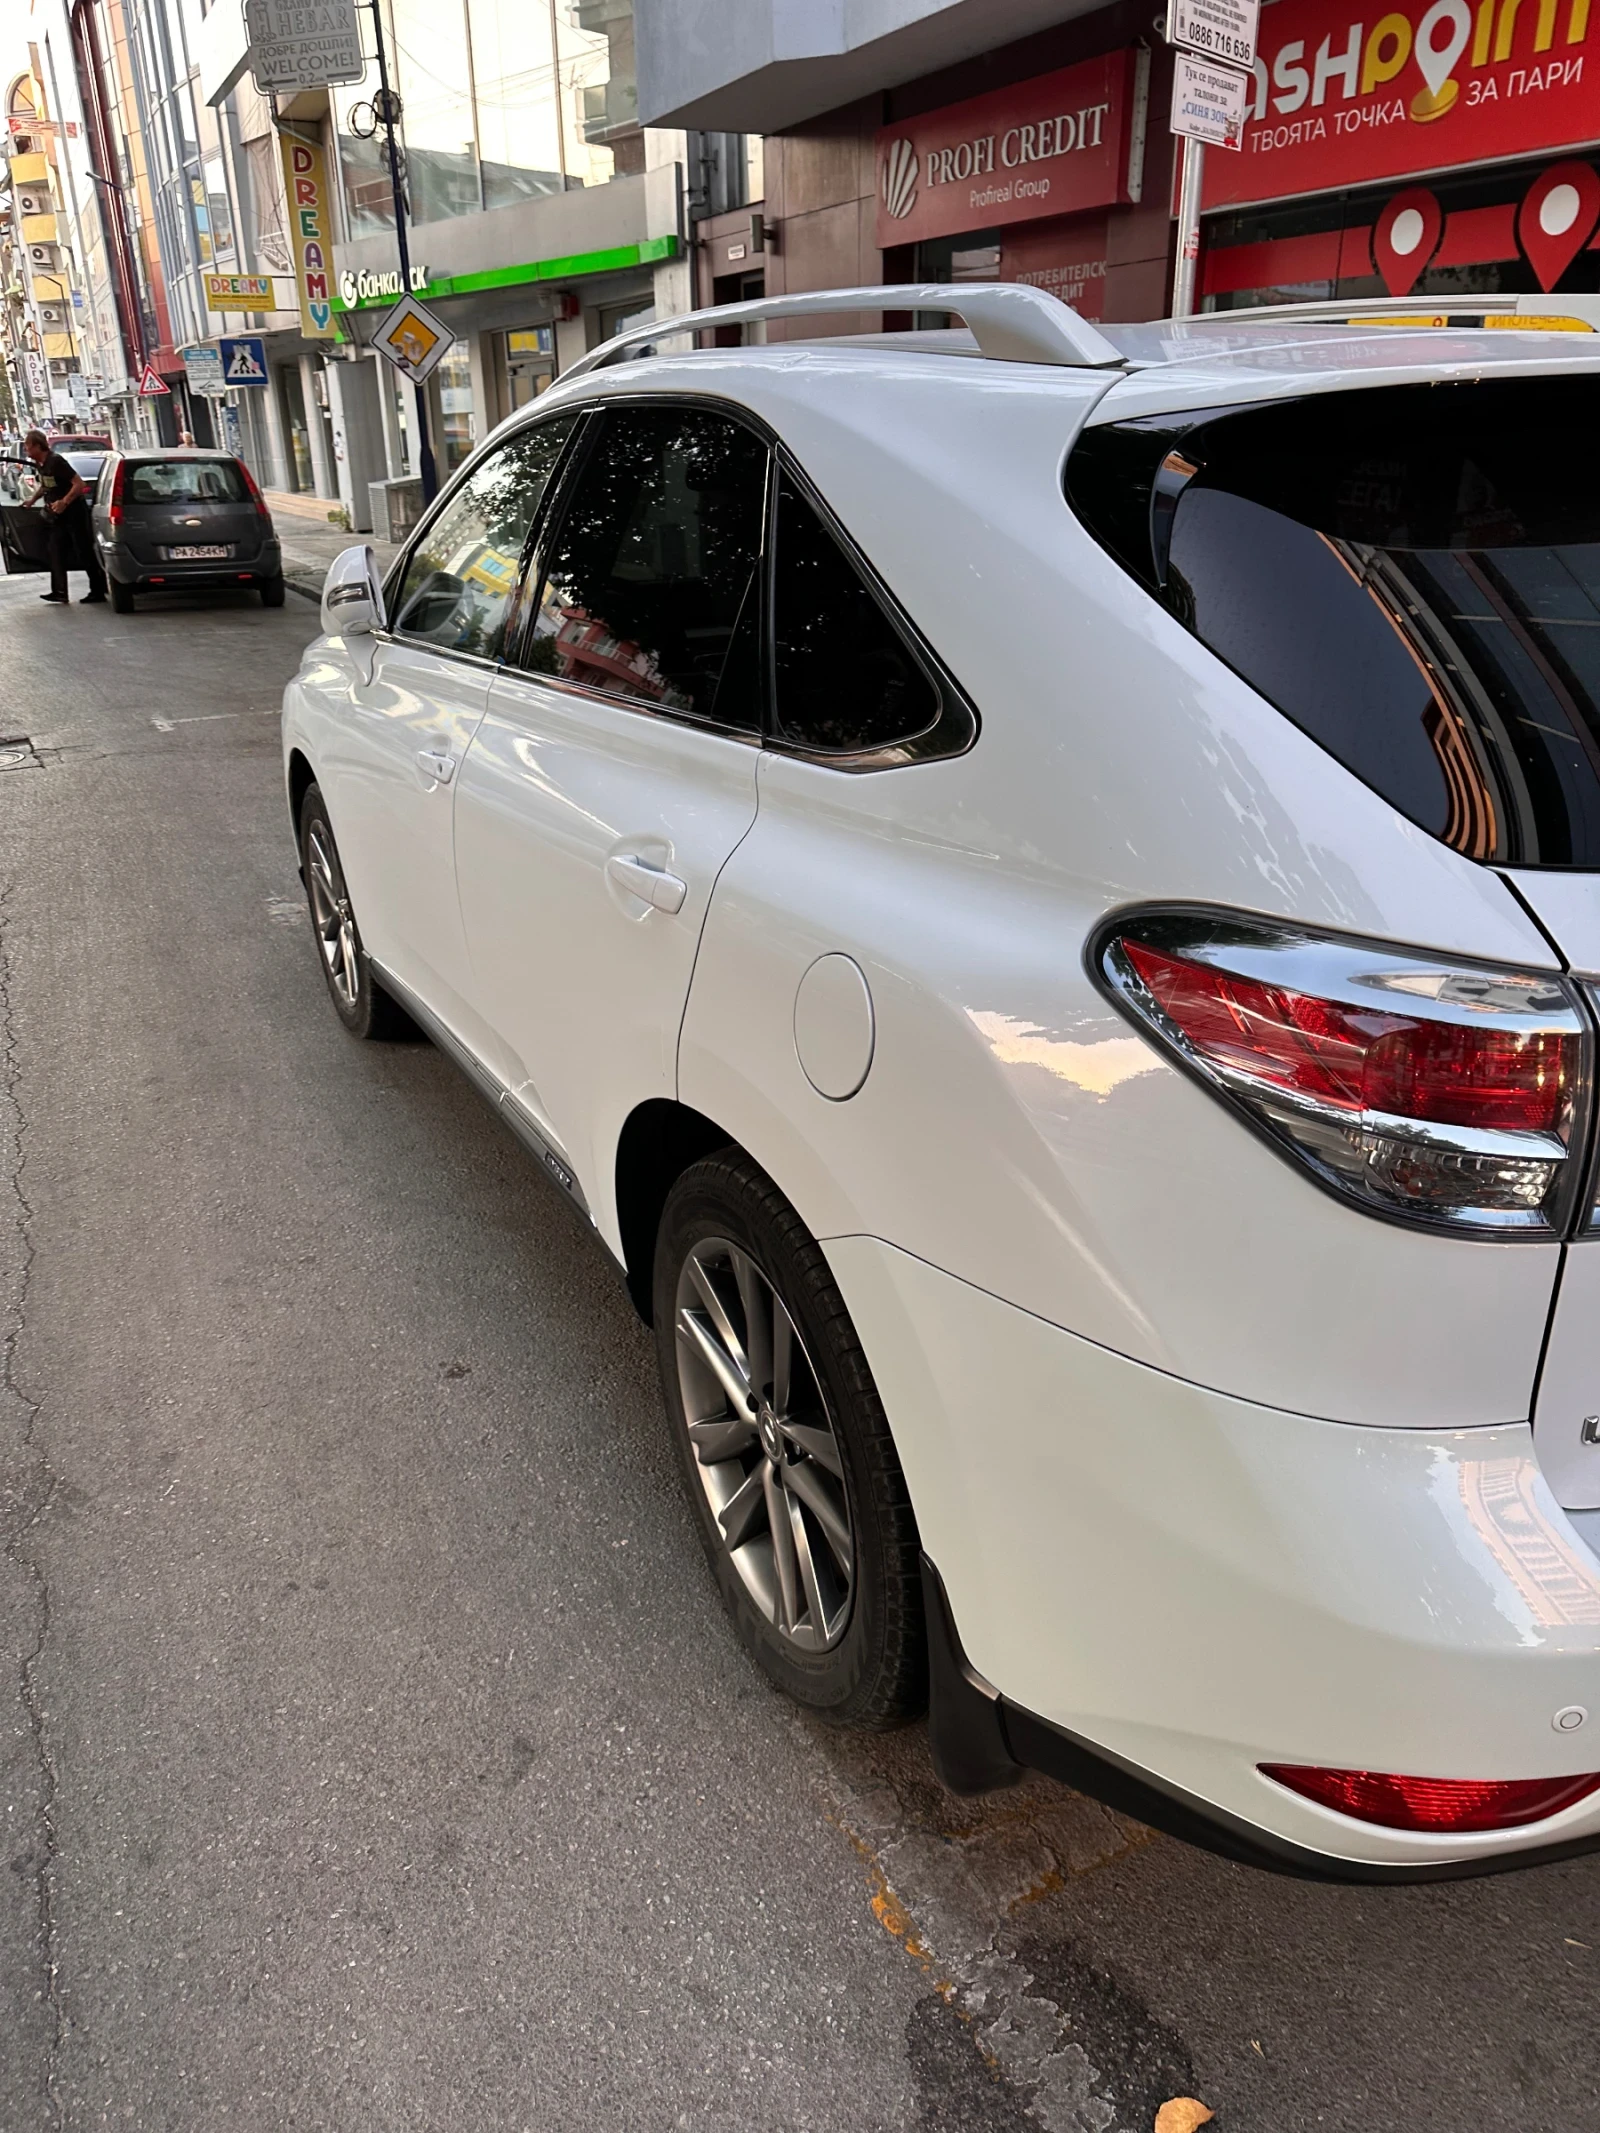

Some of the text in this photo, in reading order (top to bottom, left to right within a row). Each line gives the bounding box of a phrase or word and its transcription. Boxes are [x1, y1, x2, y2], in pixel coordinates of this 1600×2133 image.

[276, 6, 350, 36] HEBAR
[258, 37, 353, 59] ДОБРЕ ДОШЛИ!
[1189, 21, 1250, 61] 0886 716 636
[261, 52, 354, 76] WELCOME!
[1185, 65, 1239, 93] Тук се продават
[1194, 88, 1227, 106] талони за
[1251, 57, 1584, 153] ТВОЯТА ТОЧКА ЗА ПАРИ
[1210, 109, 1227, 124] ЗОН
[926, 103, 1109, 188] PROFI CREDIT
[969, 177, 1050, 208] Profireal Group
[291, 145, 331, 331] DREAMY
[210, 278, 268, 294] DREAMY
[358, 269, 398, 299] банка
[1044, 282, 1085, 302] РЕДИТ
[29, 354, 41, 392] ЛОГОС
[175, 547, 188, 557] PA
